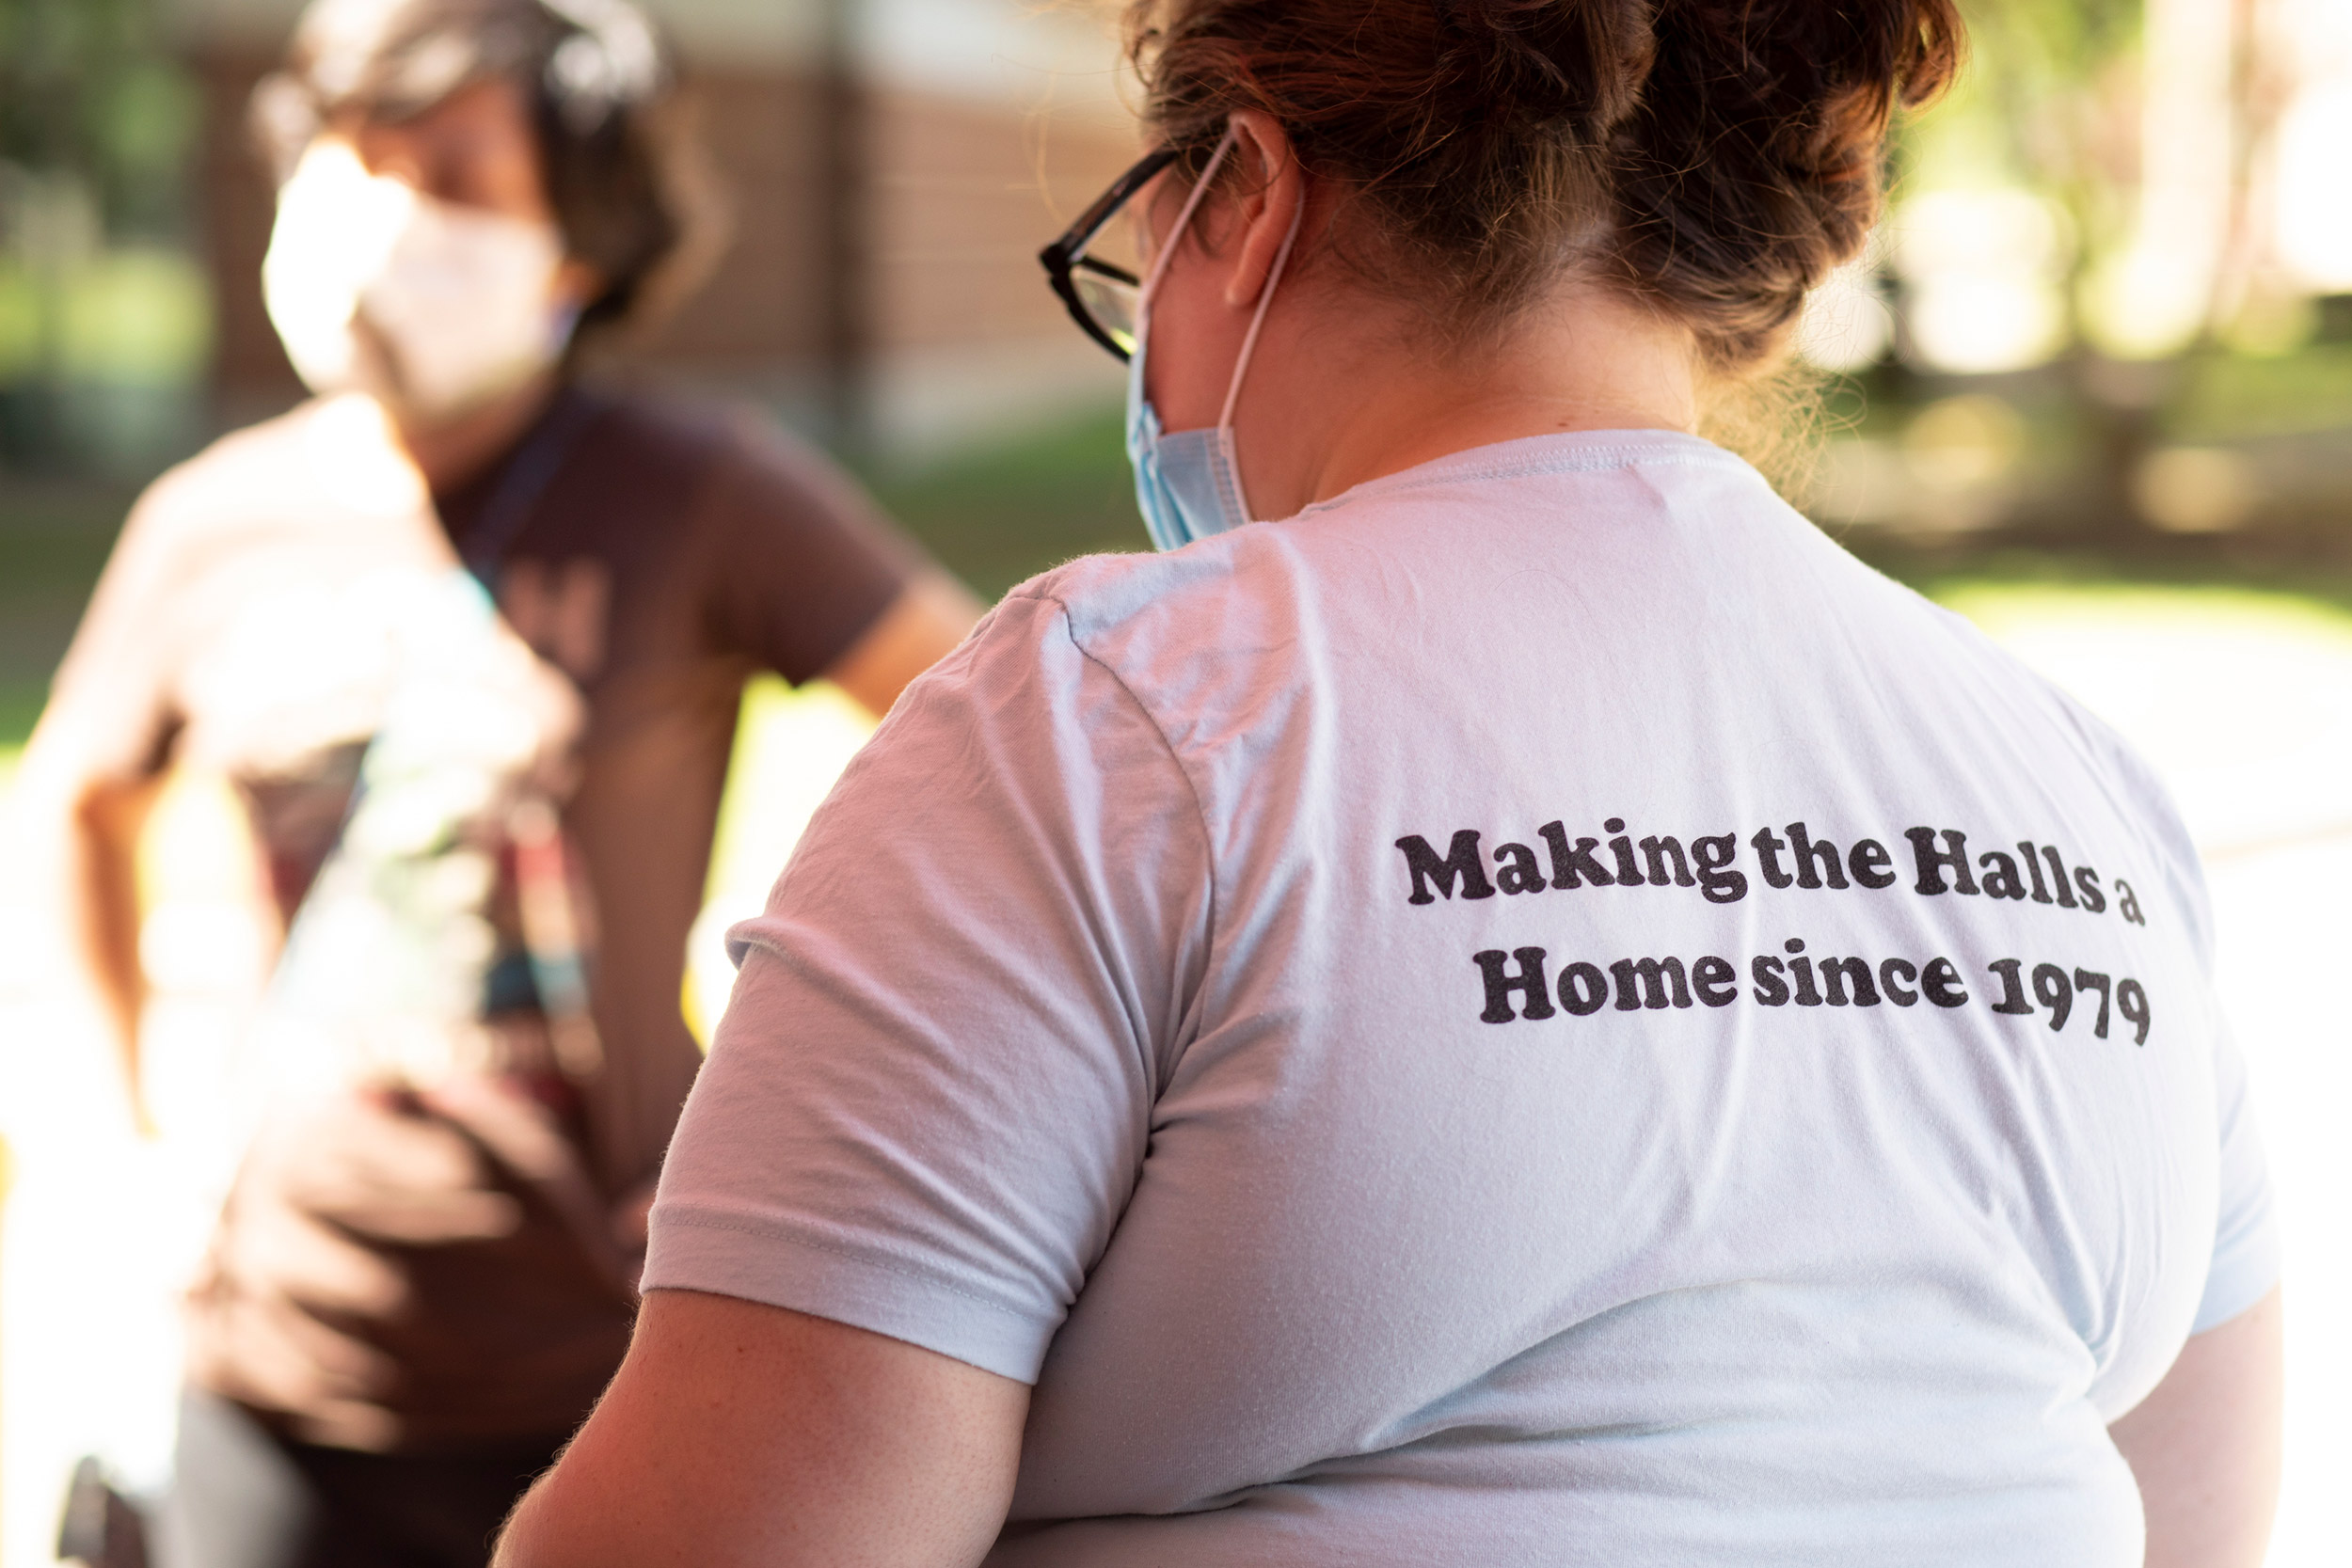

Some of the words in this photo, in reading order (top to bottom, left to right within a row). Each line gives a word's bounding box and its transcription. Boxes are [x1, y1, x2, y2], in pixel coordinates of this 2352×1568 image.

[1394, 816, 1749, 905] Making
[1750, 821, 1897, 890] the
[1903, 826, 2106, 913] Halls
[2114, 878, 2146, 927] a
[1472, 945, 1739, 1024] Home
[1751, 938, 1969, 1008] since
[1987, 958, 2151, 1047] 1979
